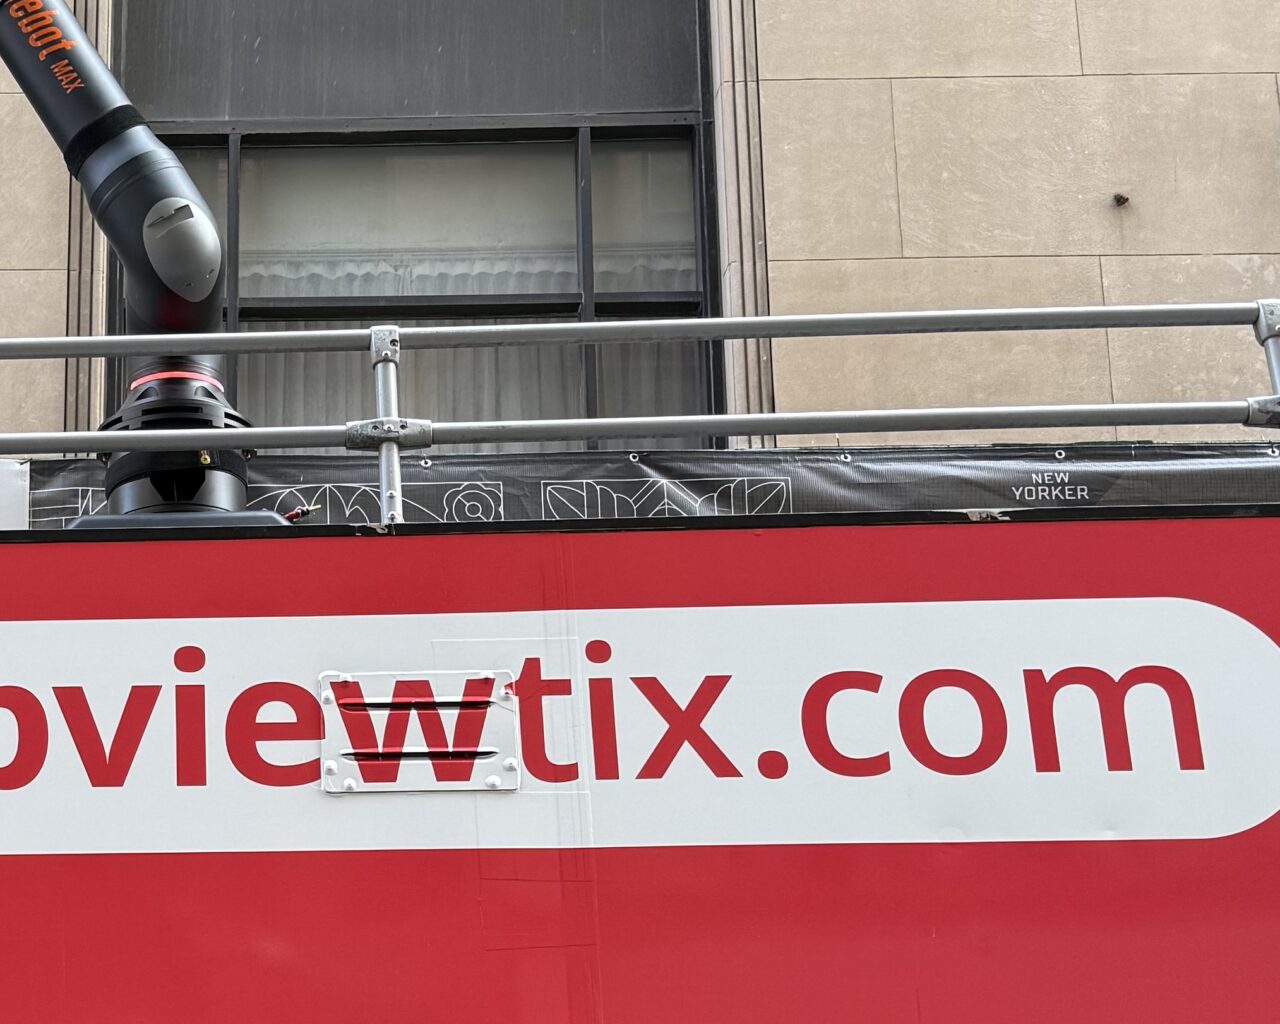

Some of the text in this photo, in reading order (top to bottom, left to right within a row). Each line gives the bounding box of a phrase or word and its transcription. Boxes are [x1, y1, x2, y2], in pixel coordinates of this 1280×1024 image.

[50, 59, 85, 94] MAX
[1031, 472, 1069, 485] NEW
[1011, 485, 1090, 501] YORKER
